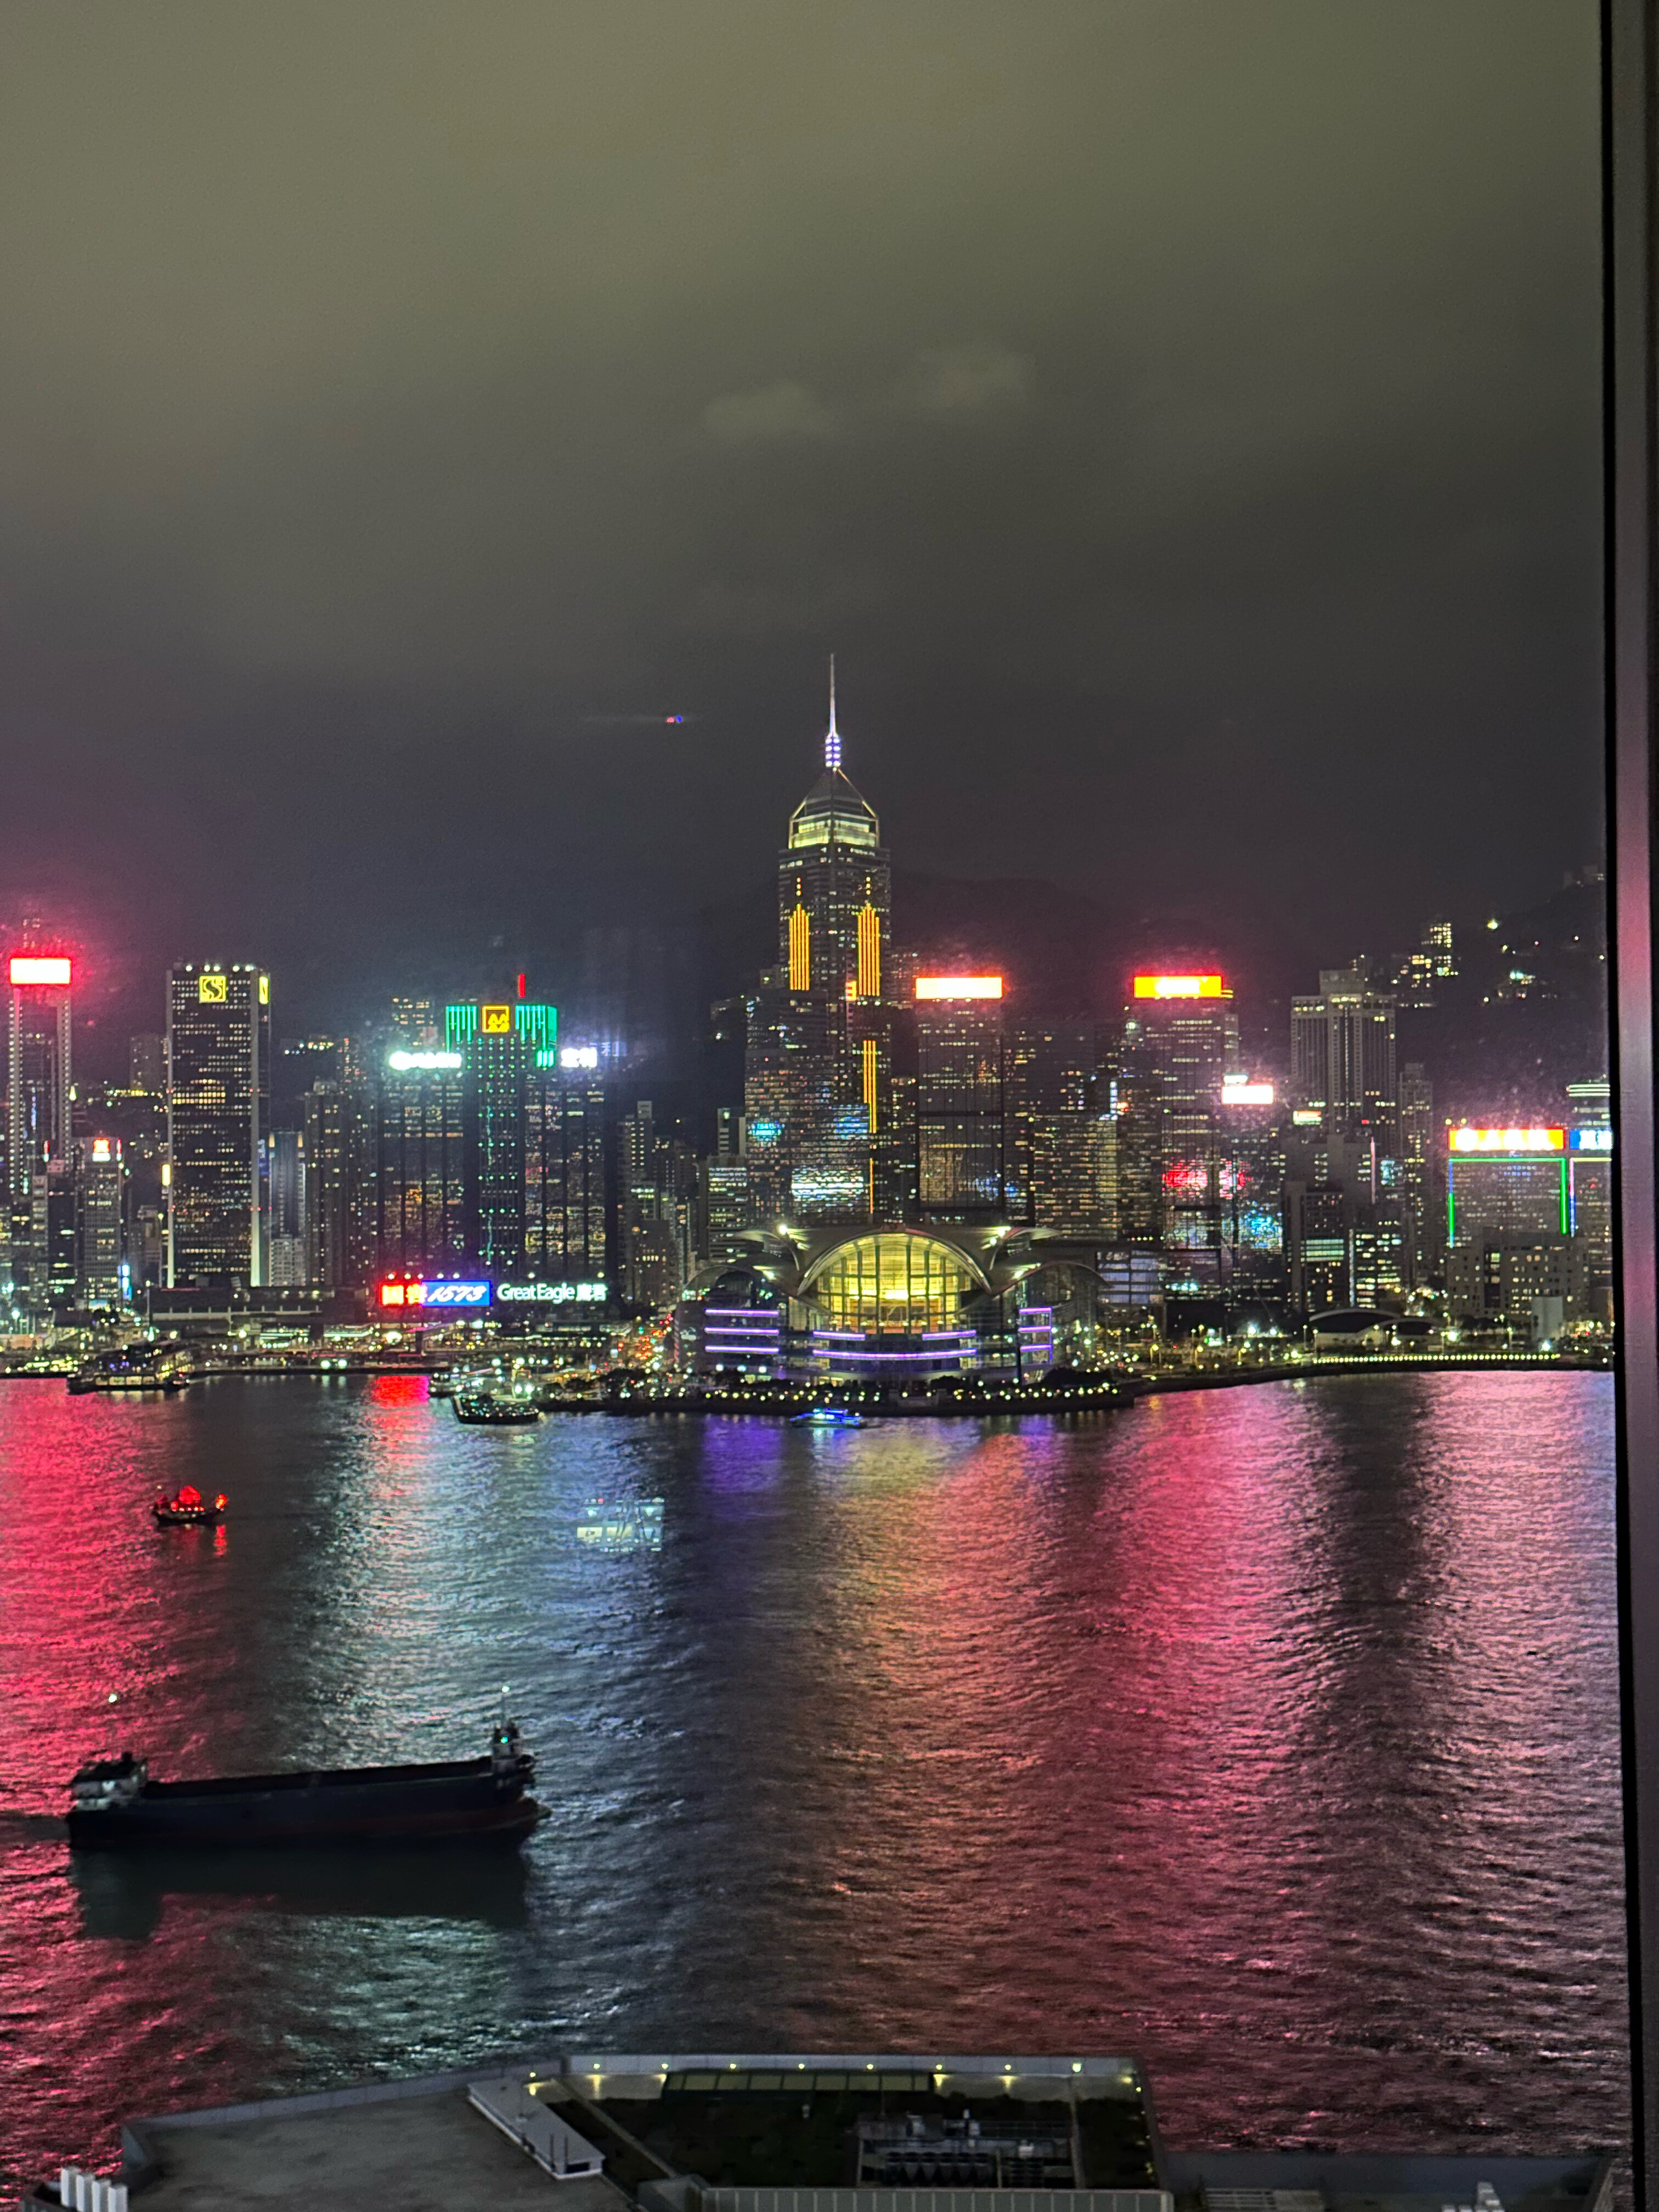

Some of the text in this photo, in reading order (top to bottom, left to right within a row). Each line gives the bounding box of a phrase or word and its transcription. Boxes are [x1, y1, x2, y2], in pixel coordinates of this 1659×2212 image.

[427, 1285, 487, 1302] 1573
[496, 1283, 537, 1301] Great
[537, 1282, 575, 1304] Eagle
